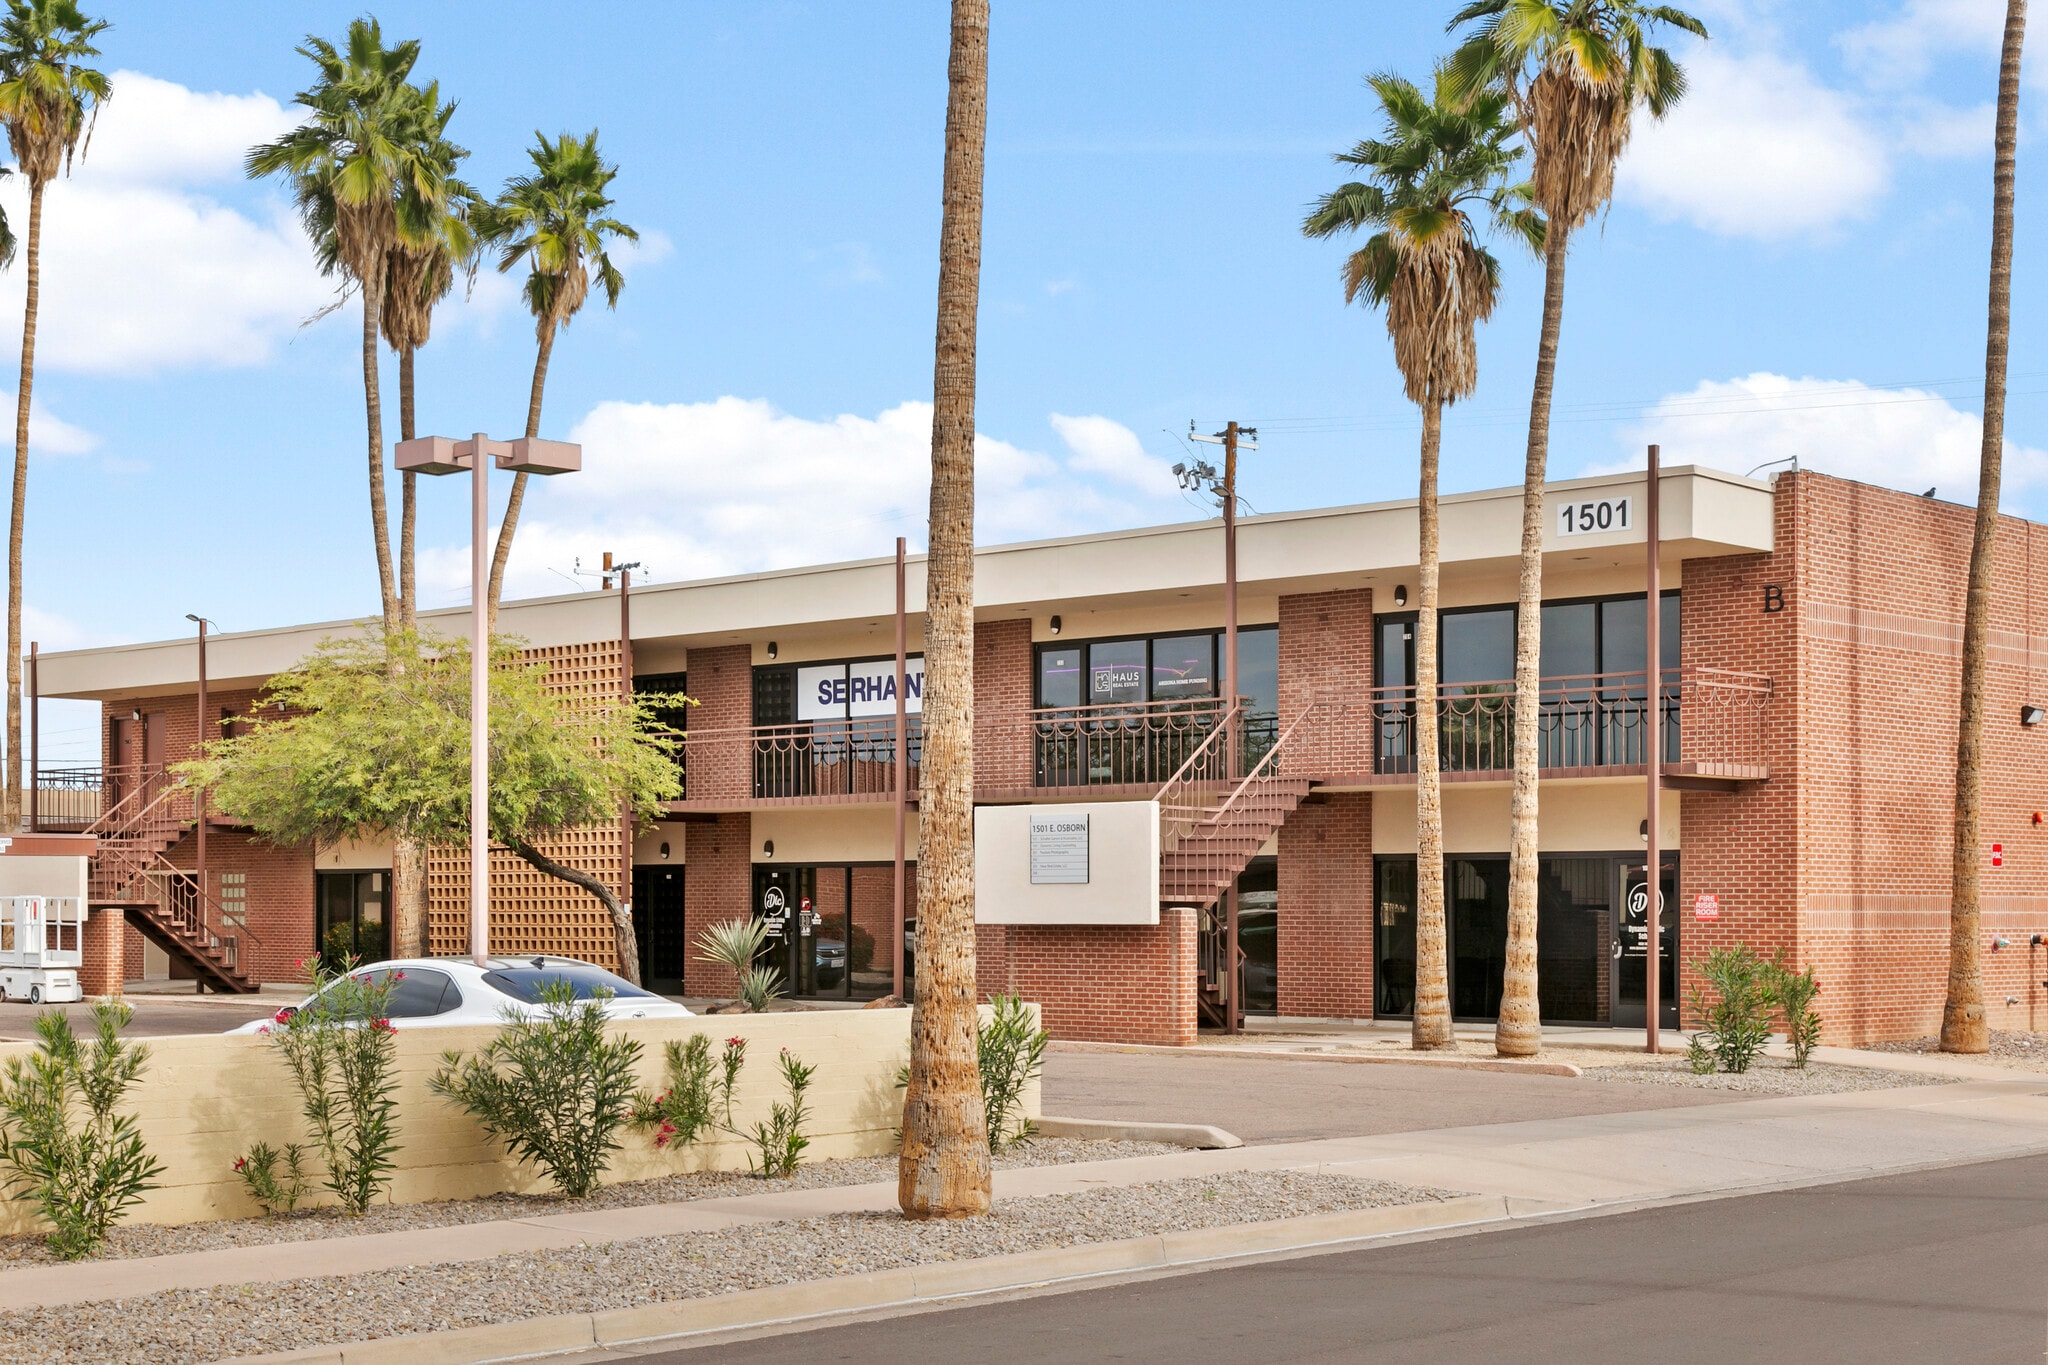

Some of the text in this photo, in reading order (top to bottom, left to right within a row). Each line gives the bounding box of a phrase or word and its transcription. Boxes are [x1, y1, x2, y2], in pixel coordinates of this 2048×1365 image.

[1562, 499, 1627, 532] 1501
[1763, 585, 1784, 612] B
[1112, 672, 1140, 682] HAUS
[818, 672, 925, 705] SERHAN
[1032, 823, 1086, 833] 1501 E. OSBORN
[1695, 908, 1718, 916] ROOM
